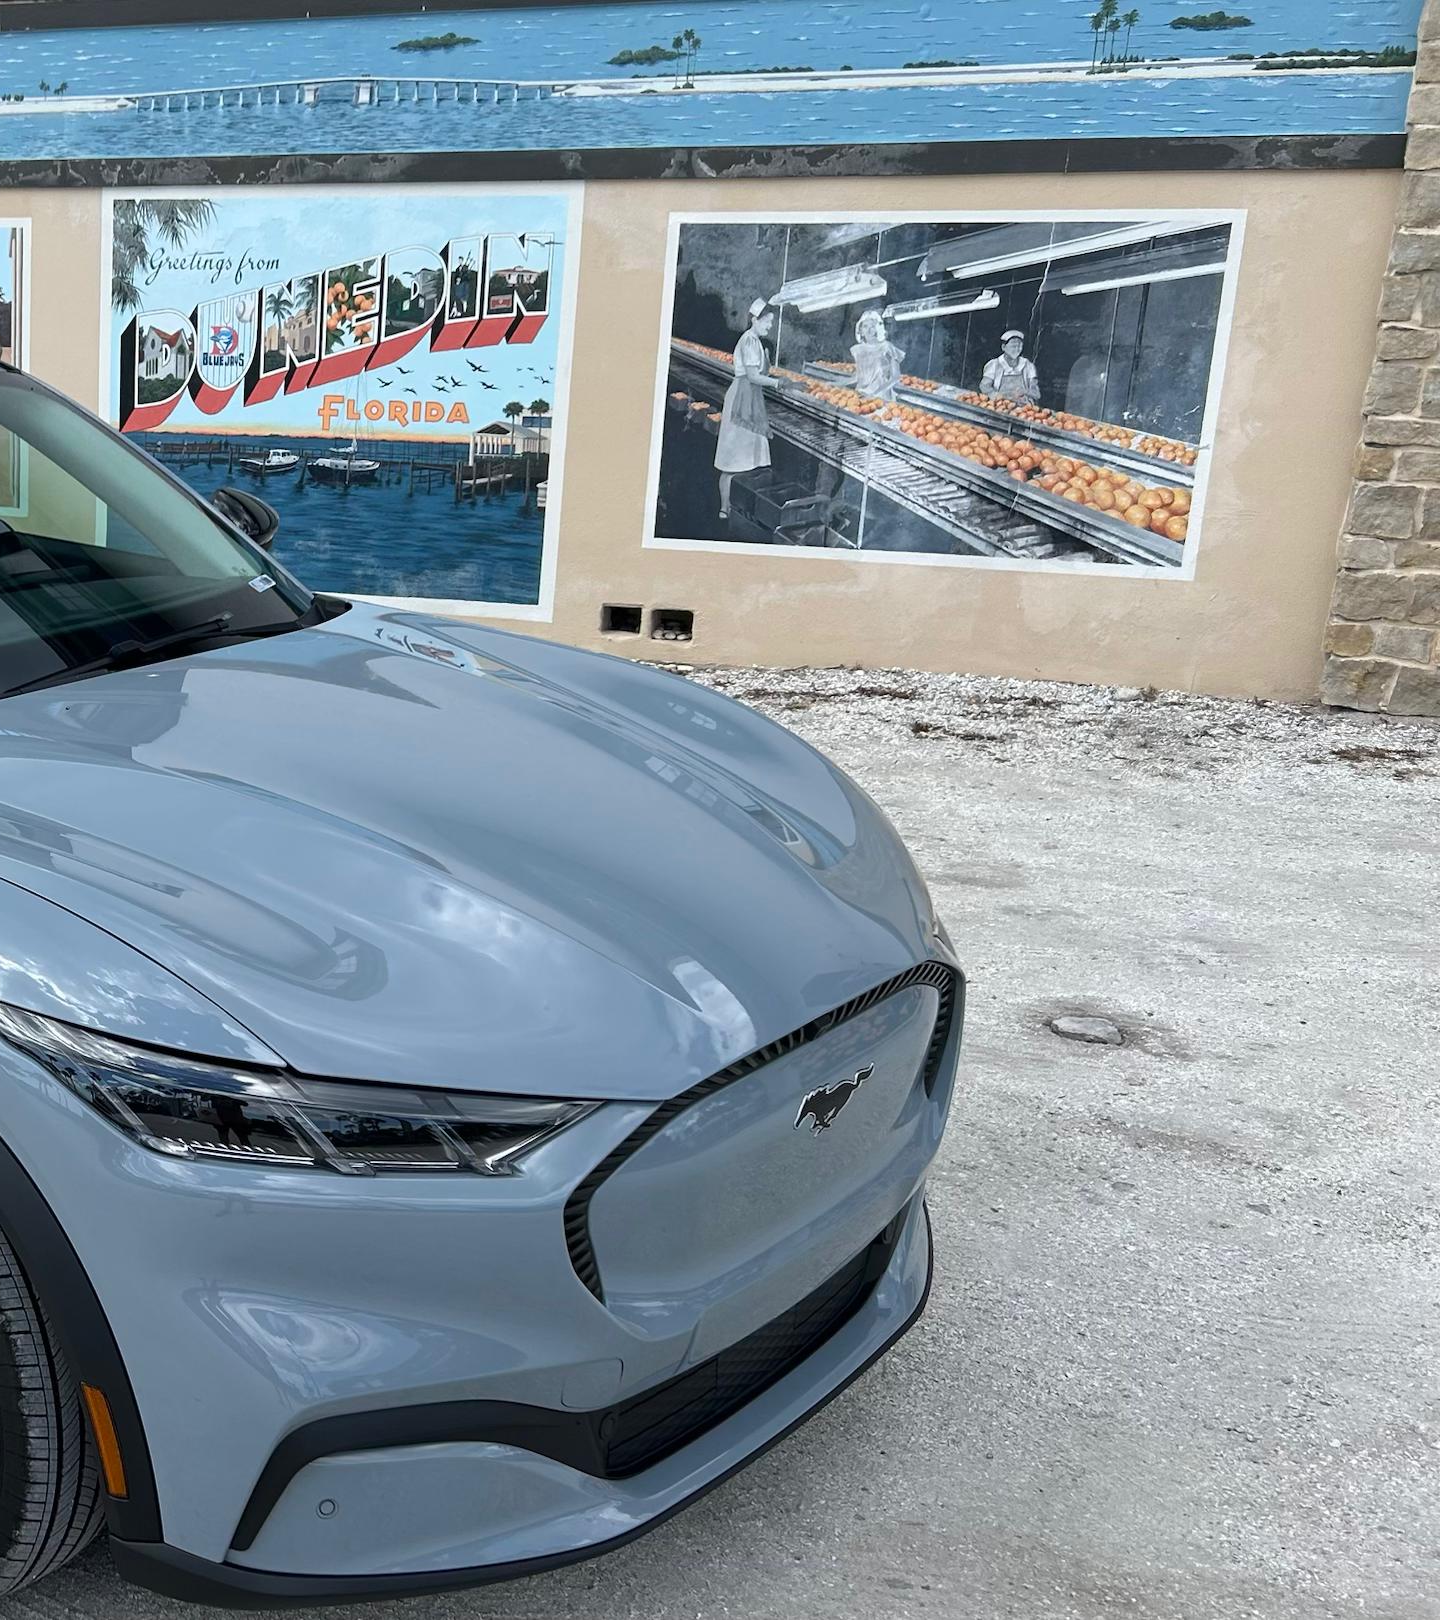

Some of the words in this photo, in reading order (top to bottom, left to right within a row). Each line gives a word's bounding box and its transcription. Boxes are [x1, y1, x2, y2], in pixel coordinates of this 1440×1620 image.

[144, 248, 233, 286] Greetings
[234, 247, 280, 285] from
[120, 232, 555, 432] DUNEDIN
[317, 395, 470, 431] FLORIDA
